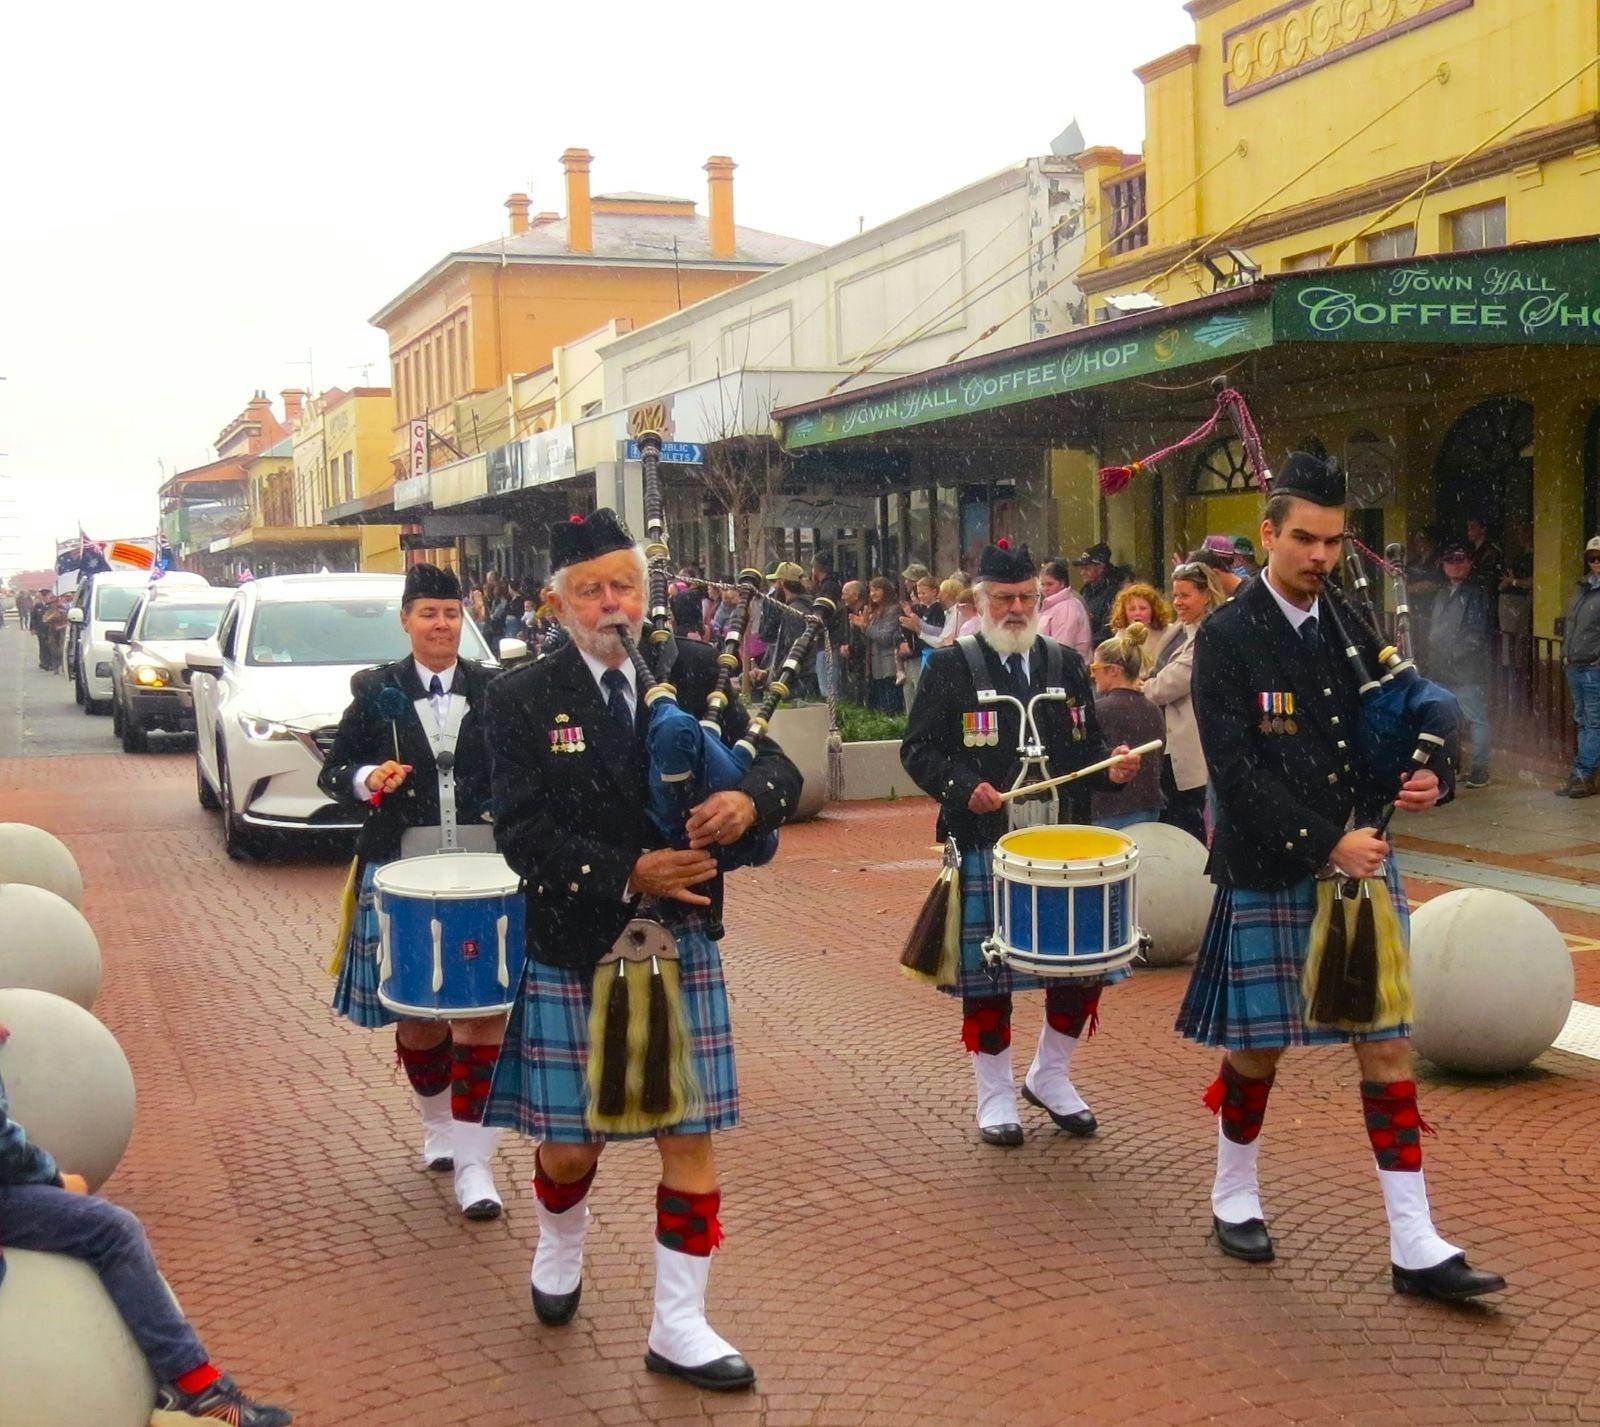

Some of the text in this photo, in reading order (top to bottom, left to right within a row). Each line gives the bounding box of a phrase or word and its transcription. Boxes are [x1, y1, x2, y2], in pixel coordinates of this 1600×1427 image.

[1388, 266, 1556, 296] TOWN HALL
[1297, 286, 1600, 332] COFFEE SH
[842, 342, 1139, 433] TOWN HALL COFFEE SHOP
[414, 425, 424, 475] CAF
[660, 452, 691, 462] OILETS
[661, 443, 688, 452] UBLIC
